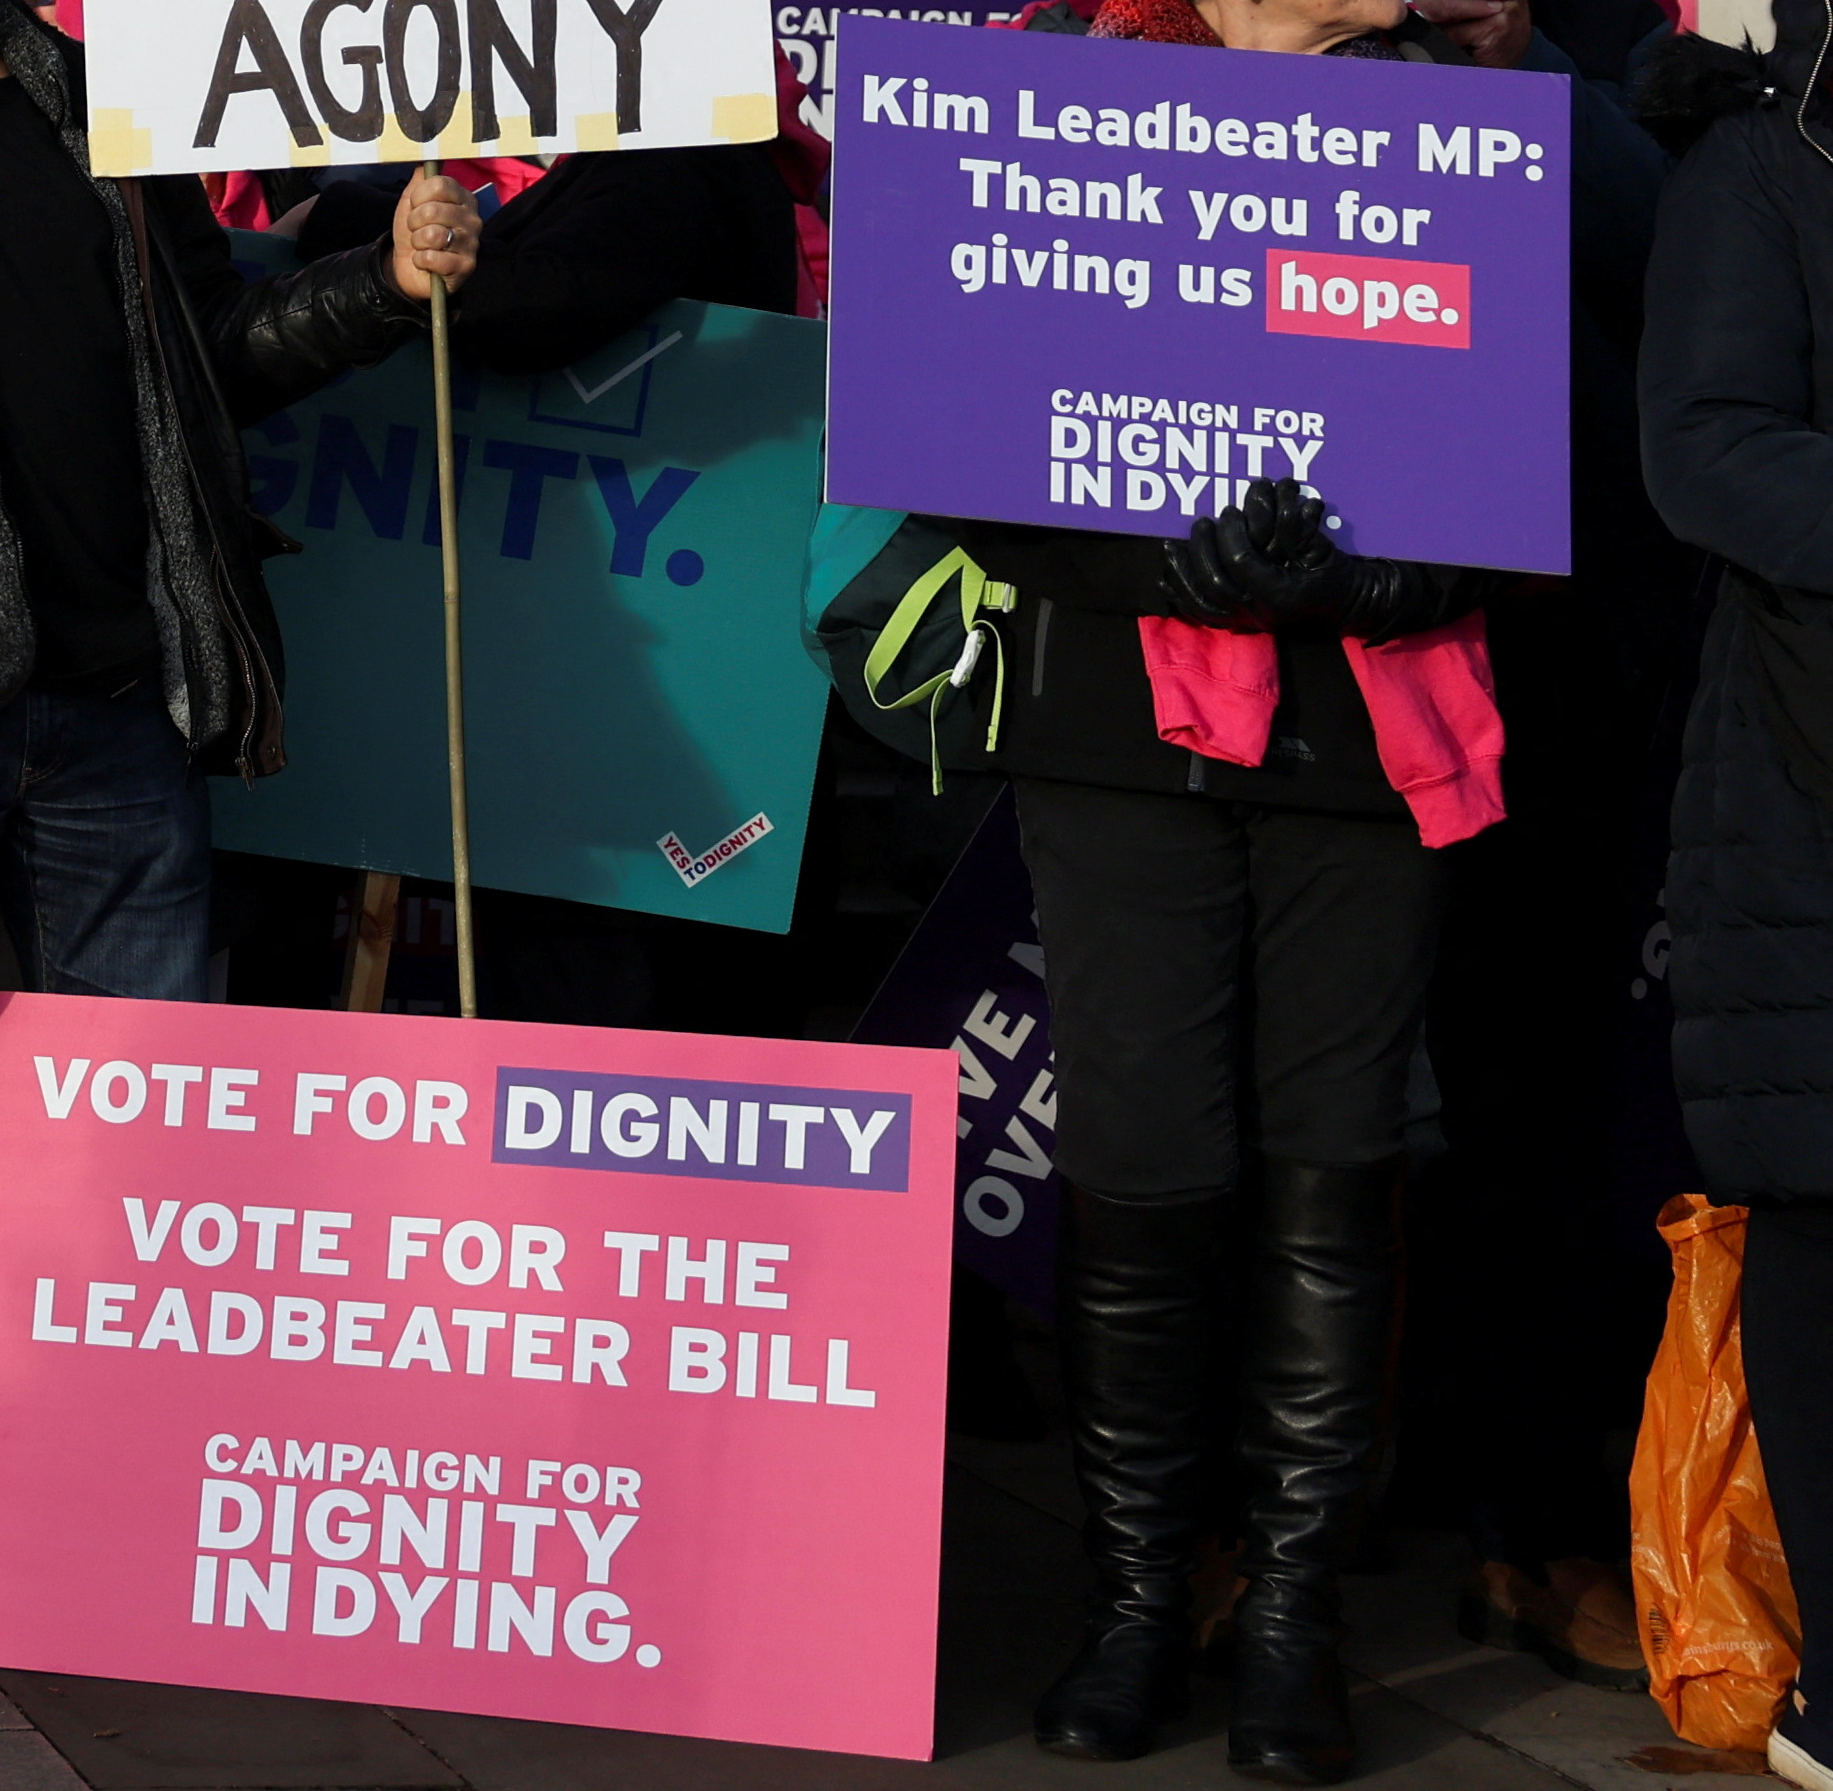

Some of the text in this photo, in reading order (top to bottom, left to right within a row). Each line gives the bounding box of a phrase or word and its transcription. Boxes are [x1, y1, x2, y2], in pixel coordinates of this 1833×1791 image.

[862, 74, 1543, 182] Kim Leadbeater MP:
[959, 157, 1431, 246] Thank you for
[950, 235, 1460, 330] giving us hope.
[1050, 415, 1325, 482] DIGNITY
[1051, 388, 1325, 439] CAMPAIGN FOR
[1049, 460, 1112, 507] IN
[663, 836, 690, 869] YES
[32, 1054, 897, 1176] VOTE FOR DIGNITY
[123, 1197, 791, 1311] VOTE FOR THE
[31, 1277, 877, 1408] LEADBEATER BILL
[204, 1433, 642, 1510] CAMPAIGN FOR
[196, 1478, 640, 1586] DIGNITY
[192, 1554, 661, 1669] IN DYING.
